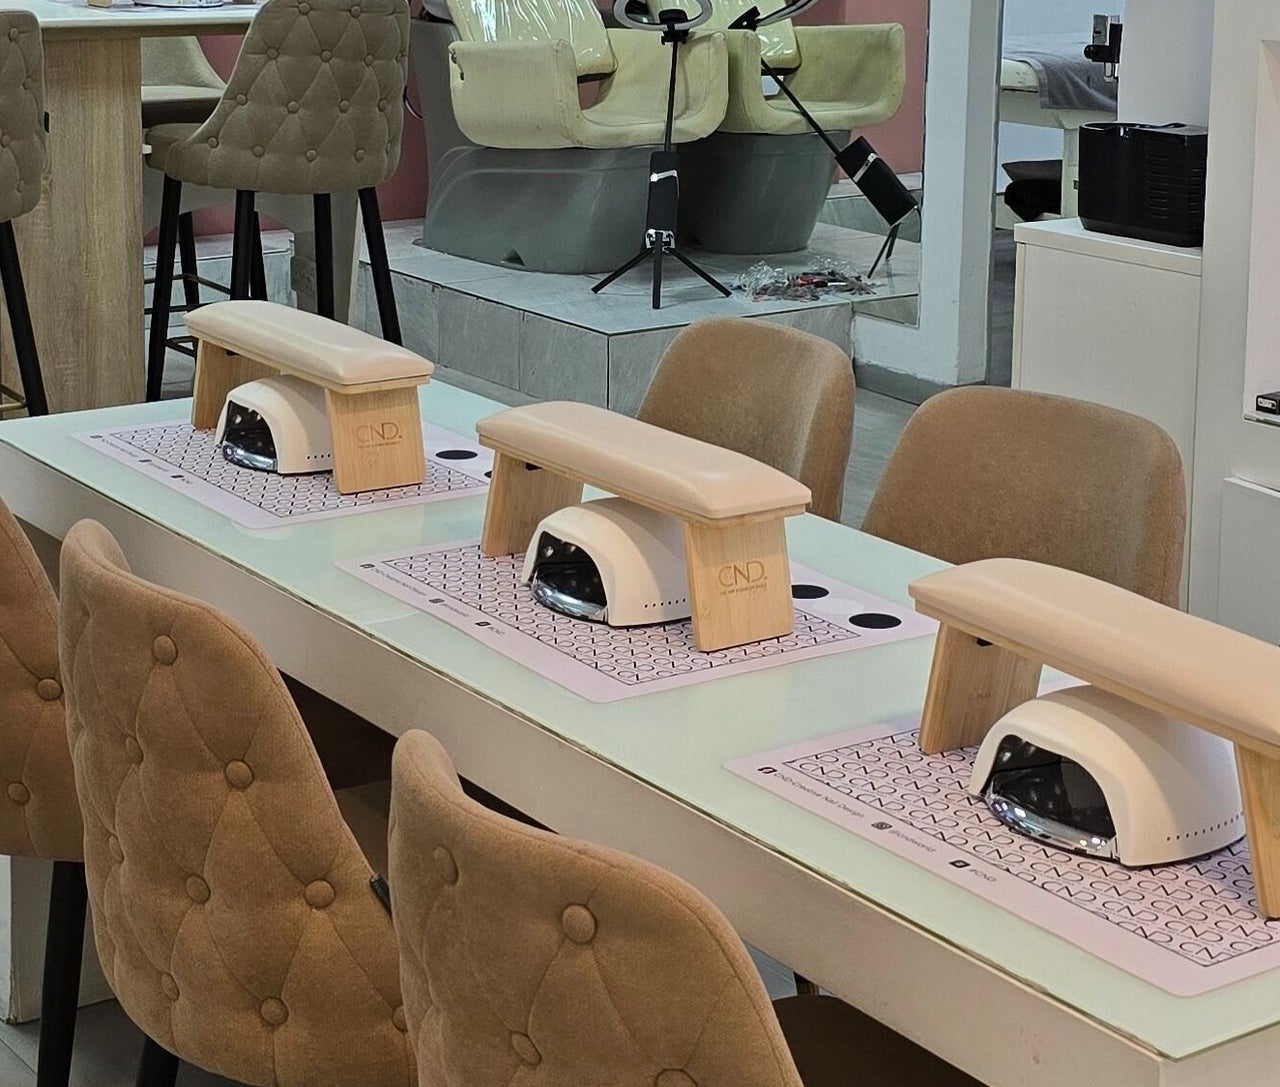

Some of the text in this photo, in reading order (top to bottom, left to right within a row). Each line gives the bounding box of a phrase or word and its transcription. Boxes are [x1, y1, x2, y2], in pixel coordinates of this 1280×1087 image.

[356, 421, 403, 444] CND
[718, 560, 769, 588] CND
[877, 746, 924, 763] CND
[799, 762, 847, 780] CND
[841, 761, 889, 779] CND
[884, 761, 933, 779] CND
[848, 777, 897, 795] CND
[892, 776, 941, 795] CND
[856, 793, 906, 811] CND
[900, 793, 950, 811] CND
[908, 809, 960, 828] CND
[953, 809, 1005, 828] CND
[963, 826, 1015, 846] CND
[973, 844, 1026, 863] CND
[1019, 843, 1073, 863] CND
[1030, 862, 1084, 882] CND
[1077, 861, 1132, 882] CND
[1041, 881, 1097, 902] CND
[1089, 880, 1145, 901] CND
[1137, 880, 1194, 901] CND
[1185, 879, 1242, 900] CND
[1102, 900, 1159, 922] CND
[1150, 899, 1208, 922] CND
[1199, 899, 1257, 921] CND
[1165, 920, 1224, 942] CND
[1214, 919, 1274, 942] CND
